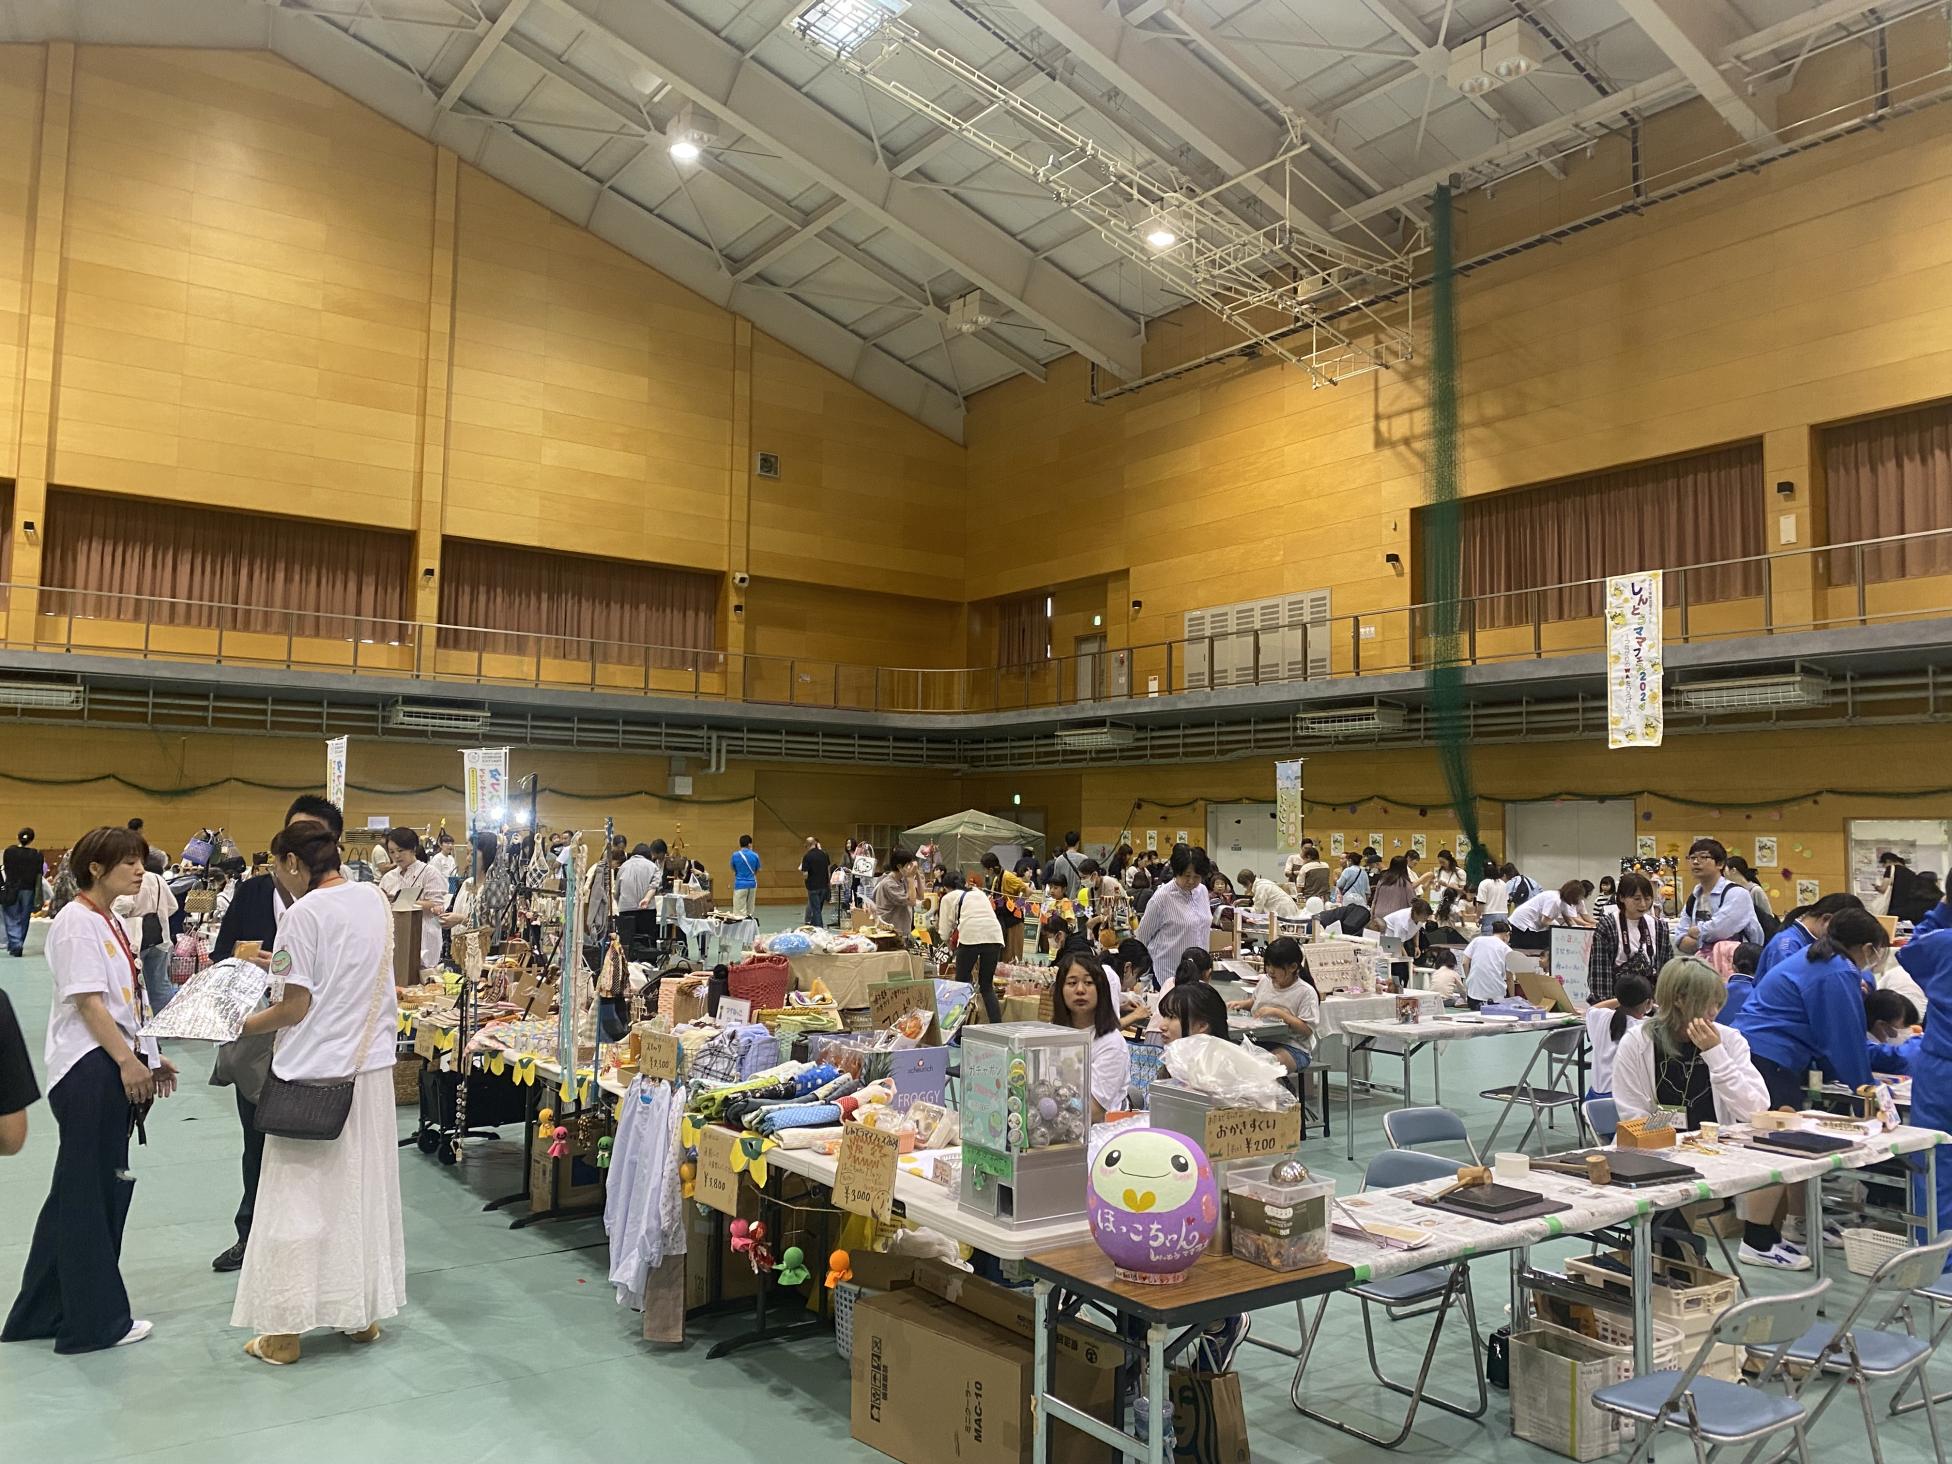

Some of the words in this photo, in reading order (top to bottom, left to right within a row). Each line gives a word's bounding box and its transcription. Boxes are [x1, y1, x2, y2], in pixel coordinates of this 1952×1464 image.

[898, 1089, 941, 1108] FROGGY
[1244, 1137, 1276, 1153] ¥200
[844, 1185, 871, 1204] ¥3000
[1097, 1208, 1200, 1251] ほっこちゃん
[973, 1380, 983, 1443] MAC-10
